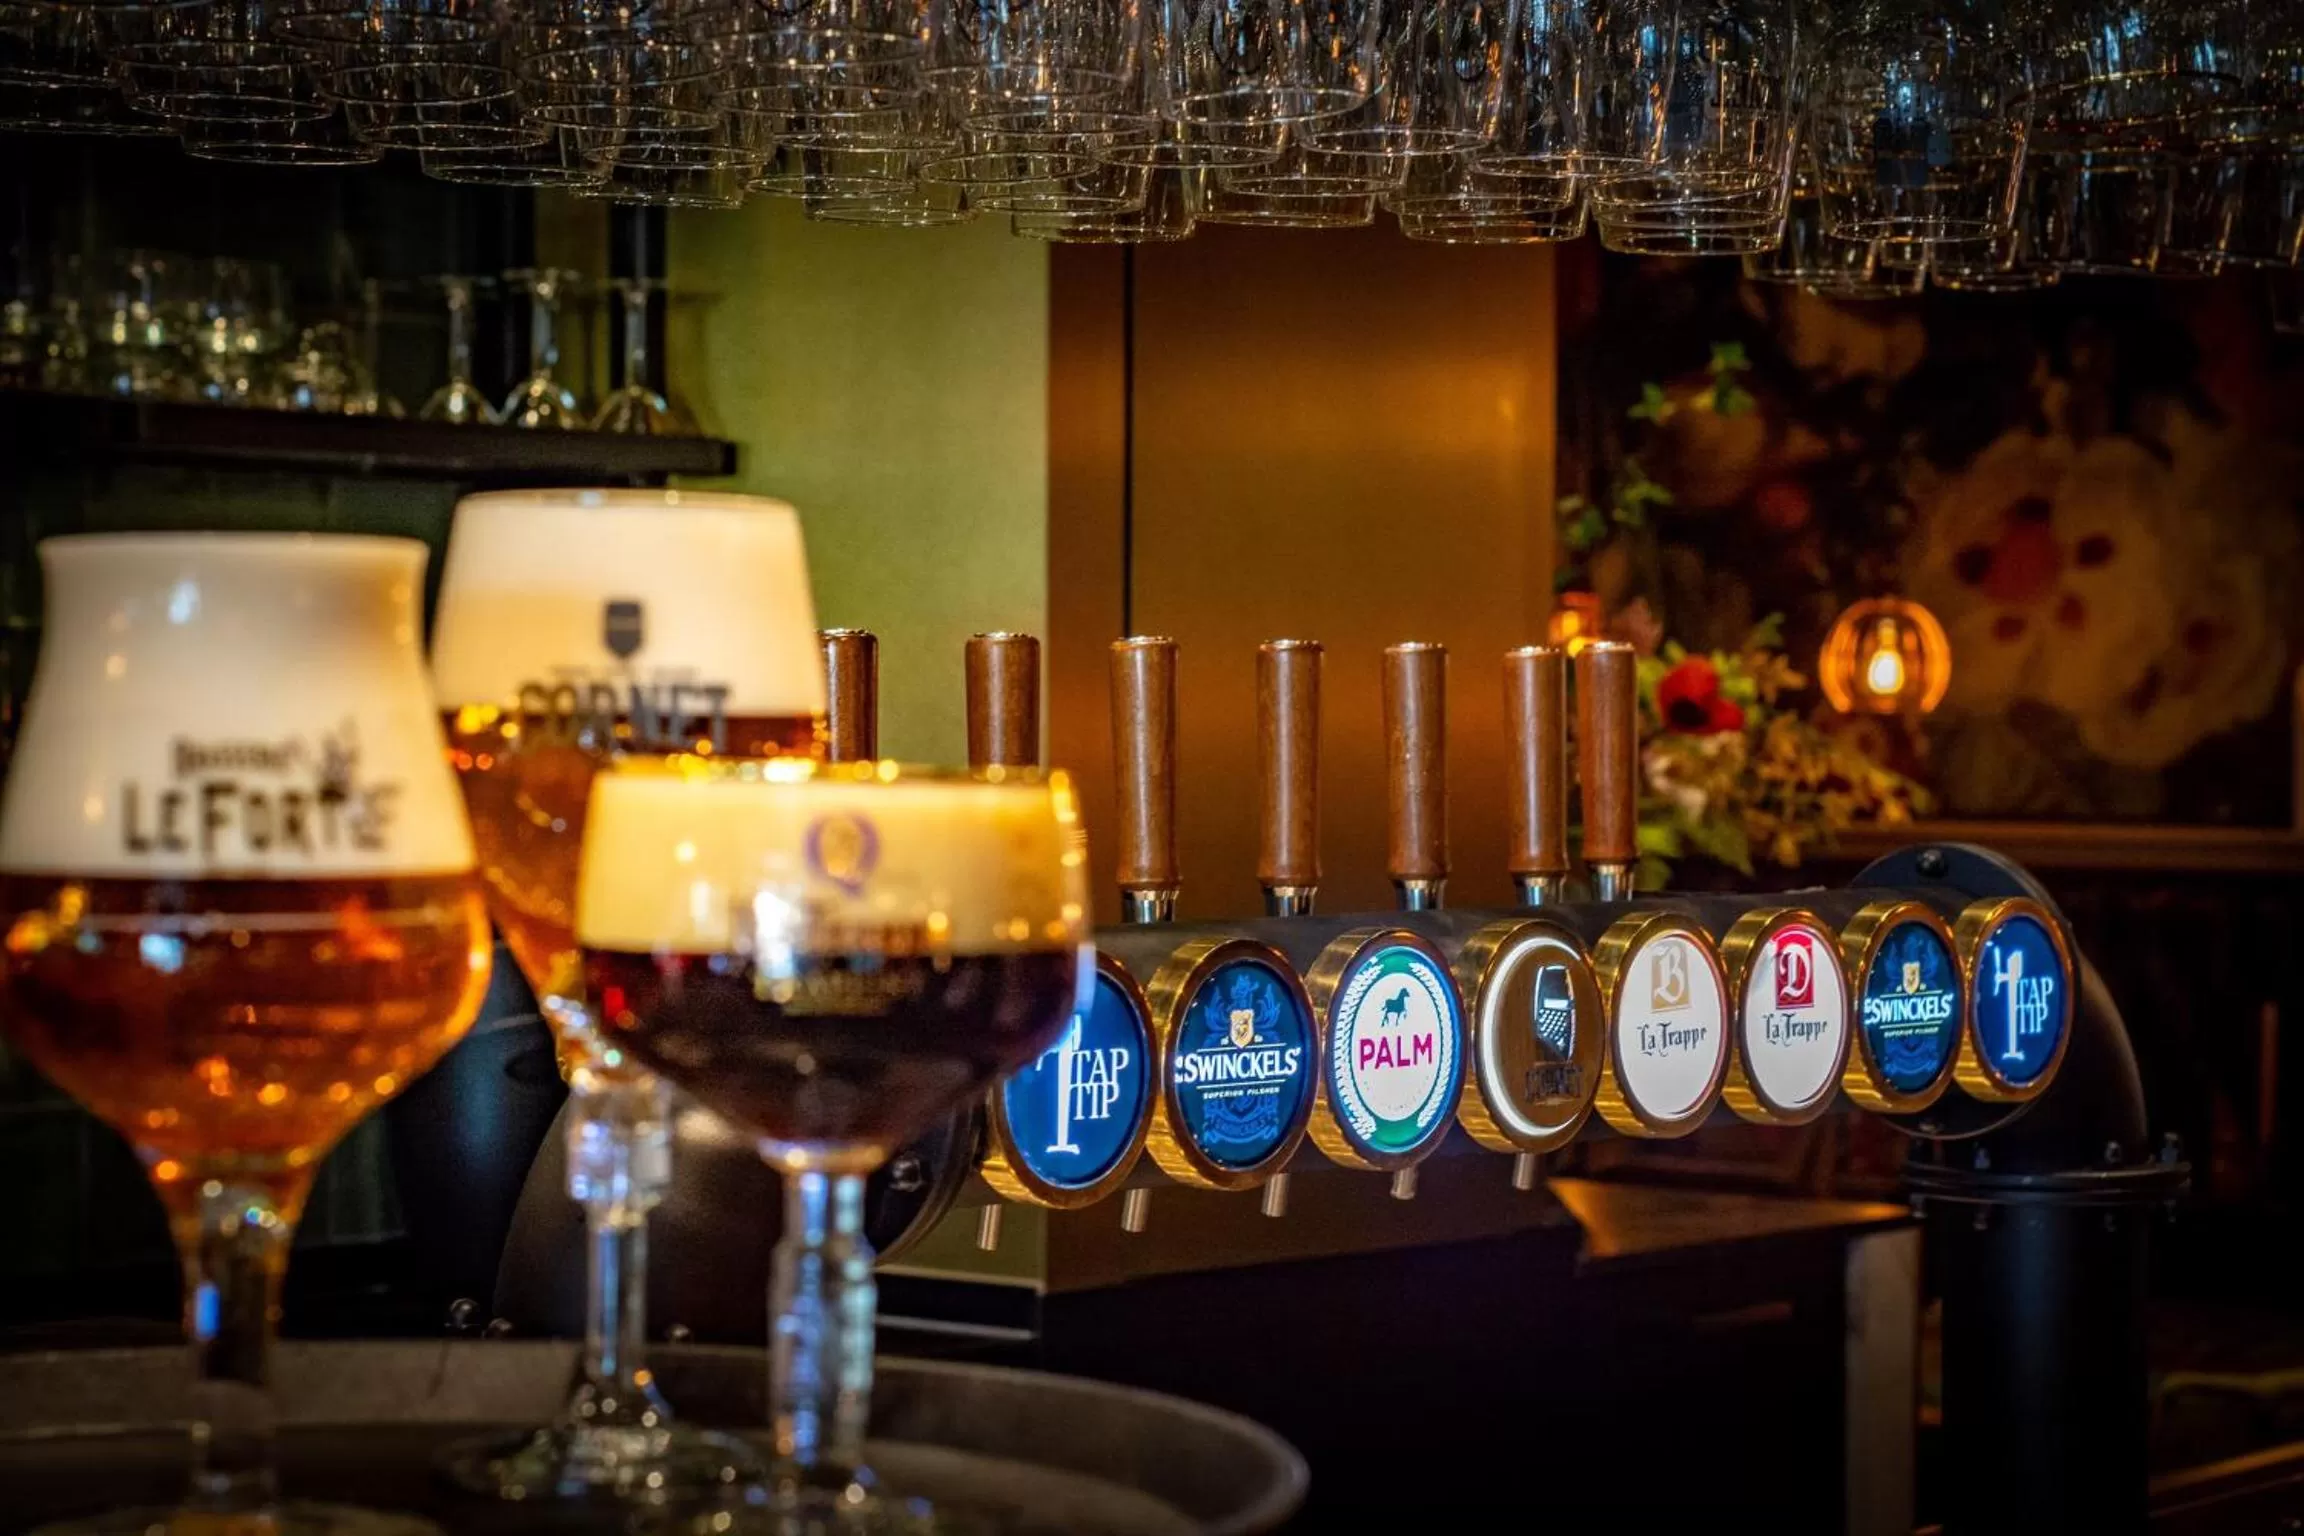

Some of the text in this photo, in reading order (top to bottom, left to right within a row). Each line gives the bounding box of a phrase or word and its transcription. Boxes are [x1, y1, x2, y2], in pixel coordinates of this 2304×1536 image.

[1657, 1022, 1707, 1057] Trappe
[1782, 1013, 1828, 1046] Trappe
[1072, 1048, 1129, 1086] TAP
[1359, 1032, 1433, 1071] PALM
[1071, 1083, 1120, 1120] TIP
